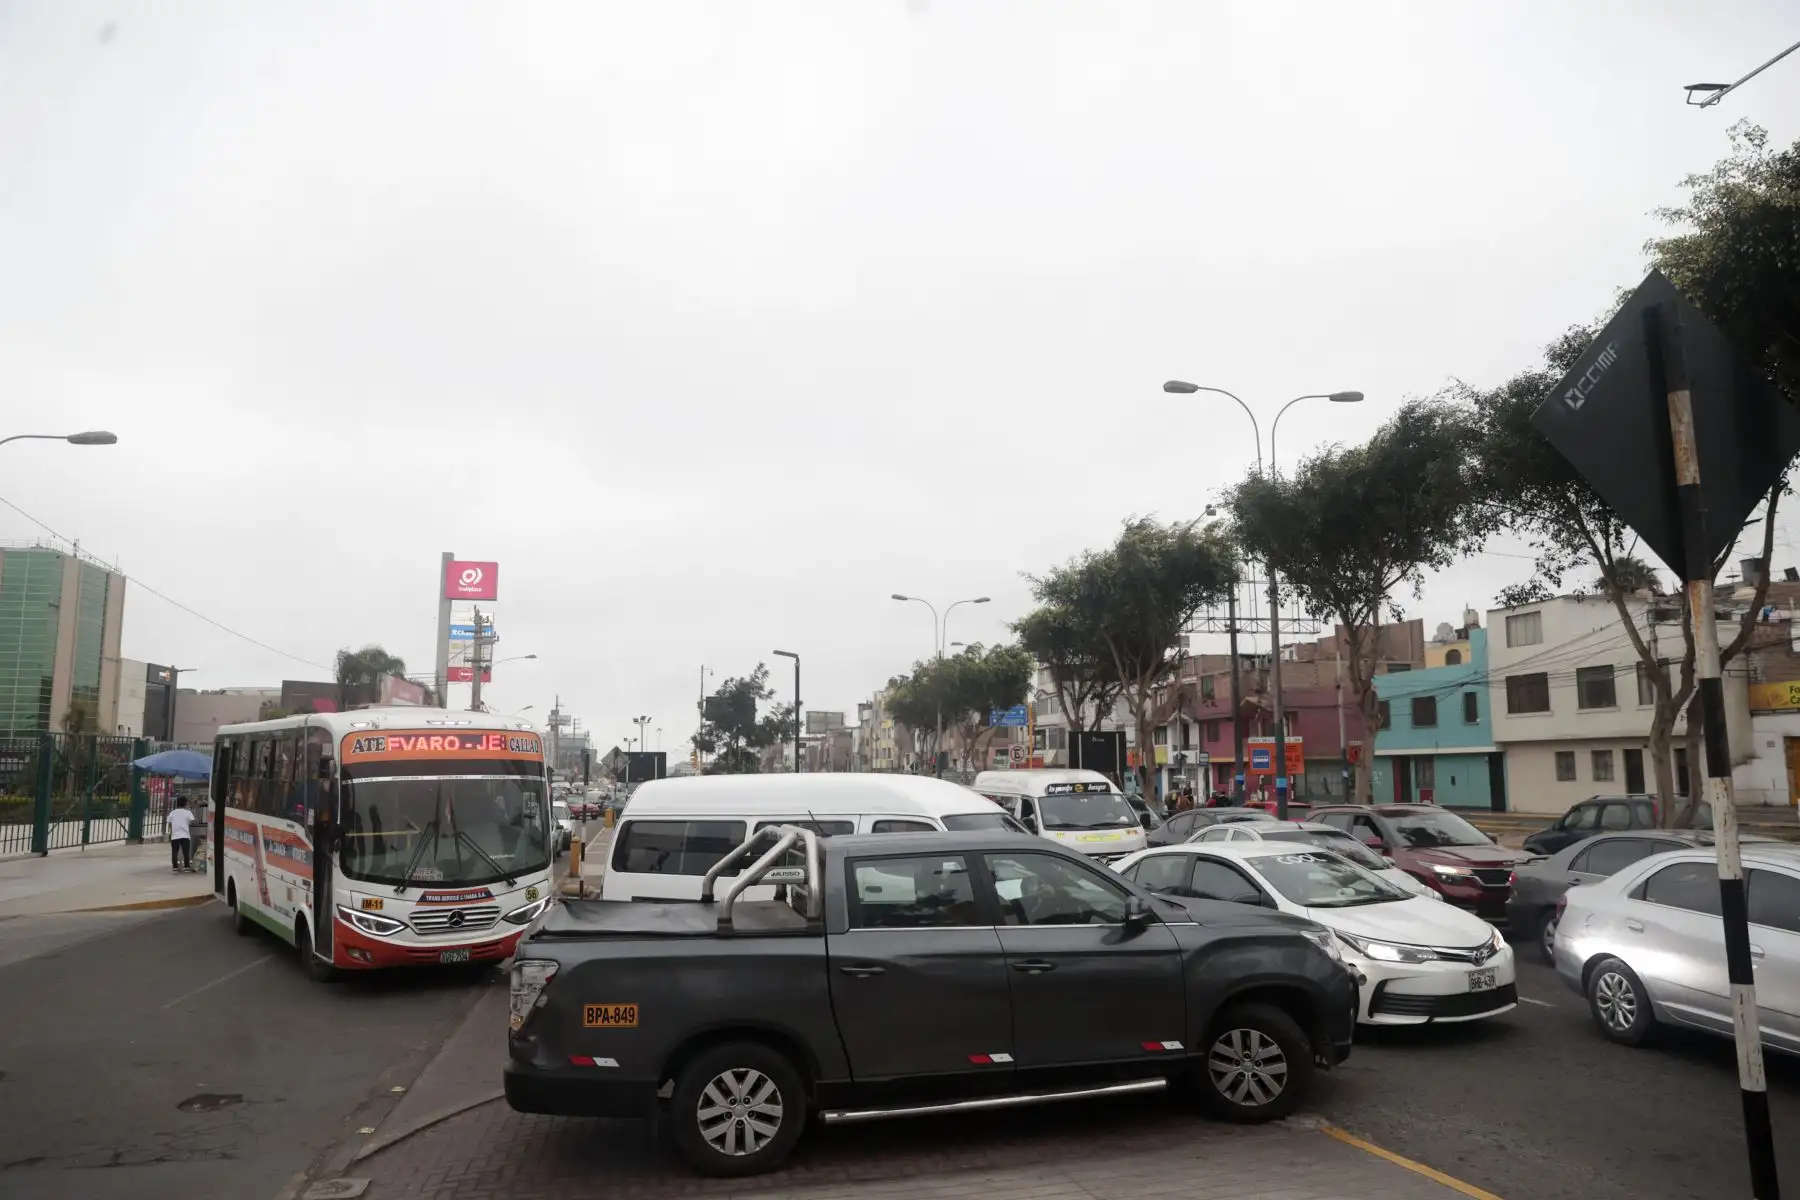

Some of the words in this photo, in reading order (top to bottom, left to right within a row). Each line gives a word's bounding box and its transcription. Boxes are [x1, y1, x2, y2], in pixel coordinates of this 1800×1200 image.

[352, 736, 386, 754] ATE
[509, 737, 540, 754] CALLAO
[586, 1006, 636, 1025] BPA-849
